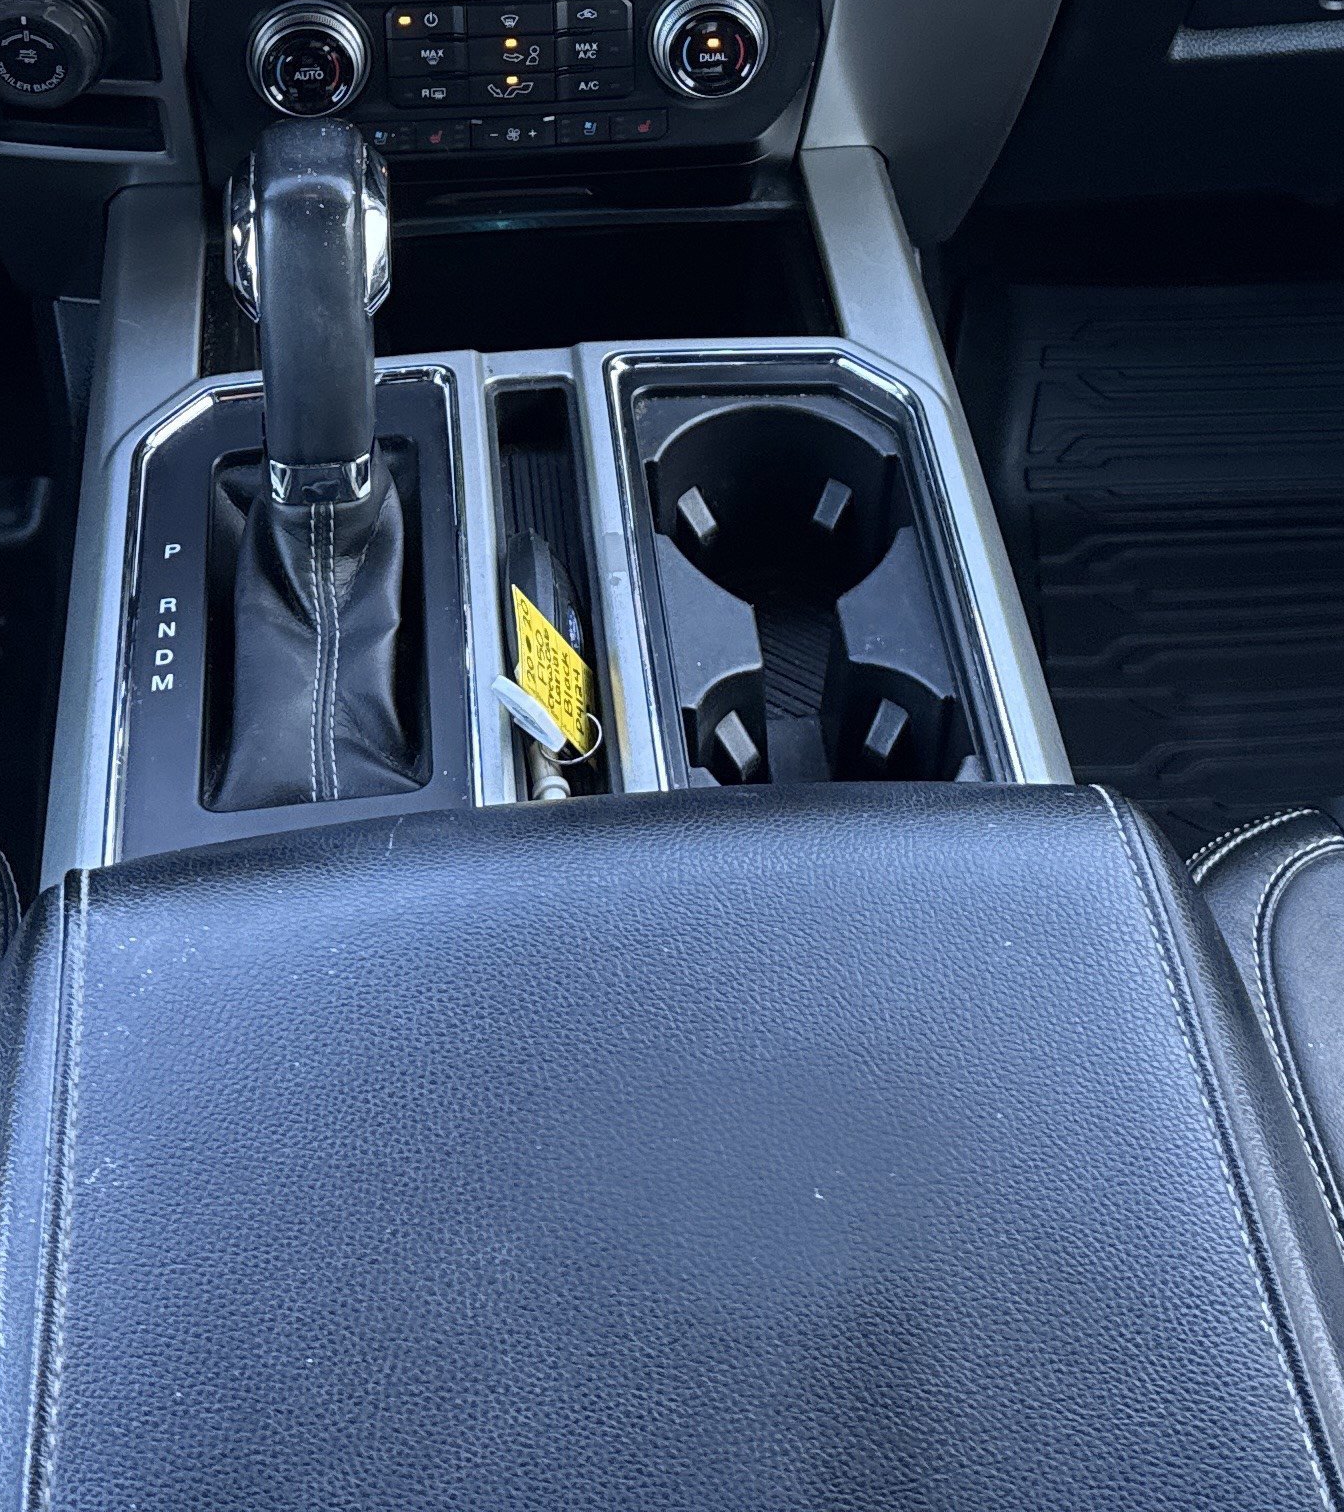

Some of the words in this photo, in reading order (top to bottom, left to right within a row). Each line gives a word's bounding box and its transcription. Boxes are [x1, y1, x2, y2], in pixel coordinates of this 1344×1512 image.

[575, 43, 598, 52] MAX
[421, 49, 444, 60] MAX
[577, 51, 597, 60] A/C
[699, 52, 728, 63] DUAL
[34, 65, 66, 92] BACKUP
[294, 69, 324, 81] AUTO
[578, 80, 600, 91] A/C
[164, 544, 181, 559] P
[159, 598, 177, 612] R
[158, 623, 176, 637] N
[156, 649, 173, 664] D
[151, 674, 173, 691] M
